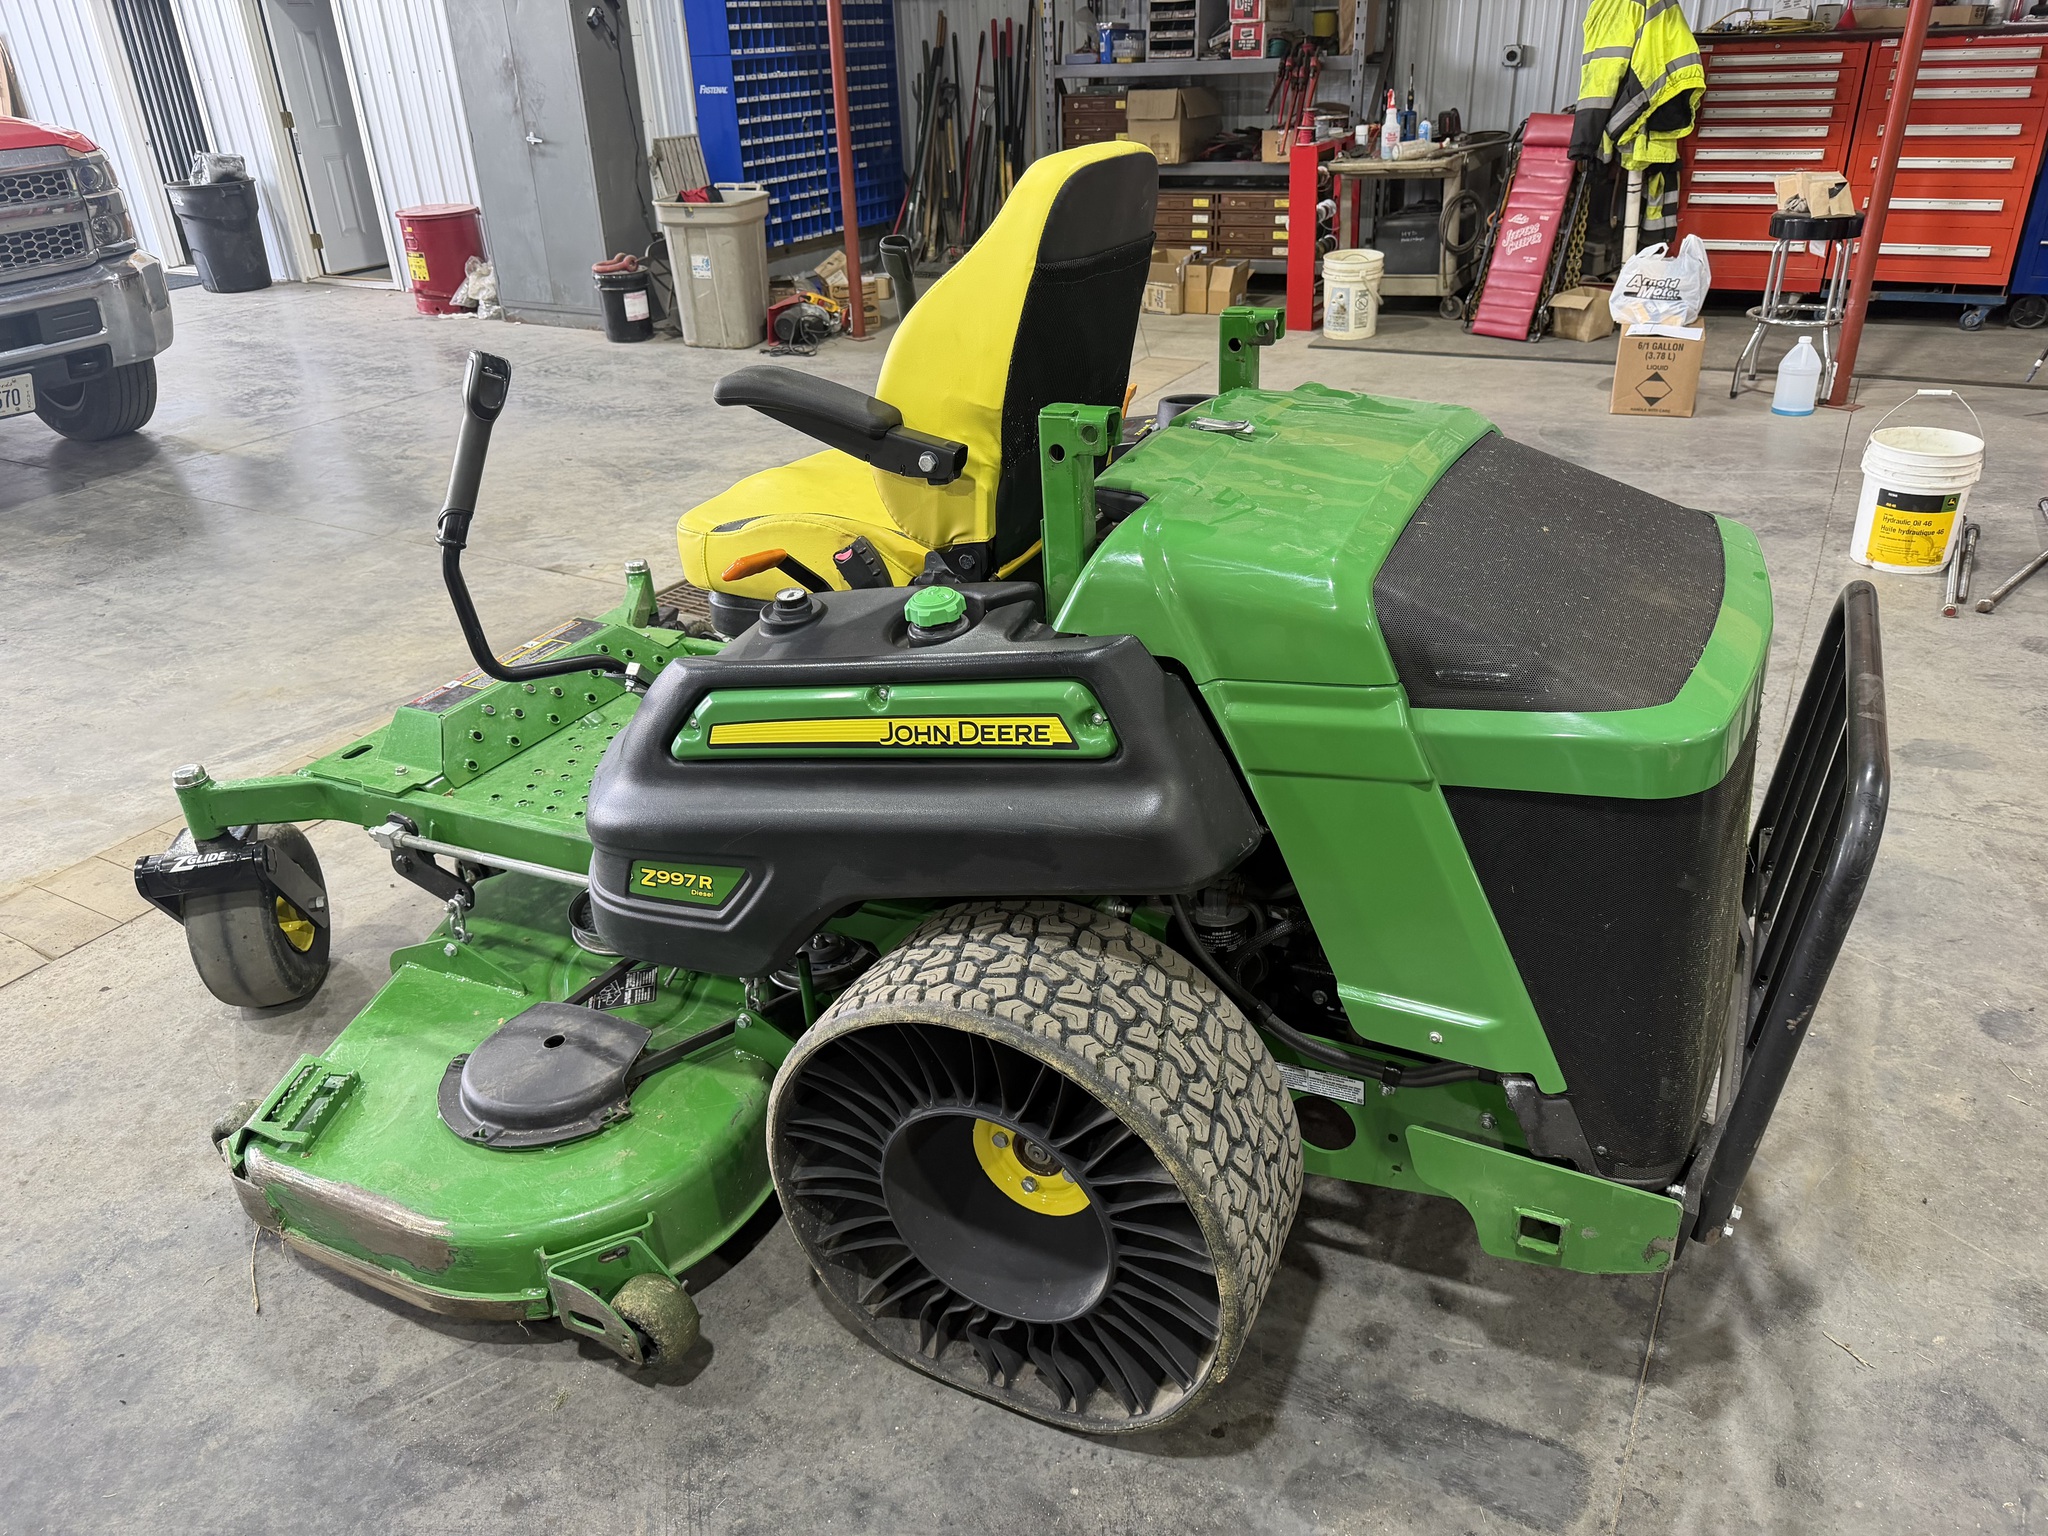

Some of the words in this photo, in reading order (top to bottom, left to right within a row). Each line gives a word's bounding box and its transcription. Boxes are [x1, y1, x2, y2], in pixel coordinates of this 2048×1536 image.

[1626, 274, 1680, 289] Arnold
[1637, 286, 1680, 298] Motor
[1637, 341, 1650, 350] 6/1
[1652, 342, 1685, 351] GALLON
[1645, 351, 1666, 361] (3.78
[1667, 352, 1676, 362] L)
[0, 388, 20, 409] 70
[1883, 515, 1911, 526] Hydraulic
[1881, 525, 1897, 533] Huile
[1898, 528, 1935, 537] hydraulique
[880, 721, 951, 743] JOHN
[958, 721, 1051, 743] DEERE
[691, 889, 714, 898] Diesel
